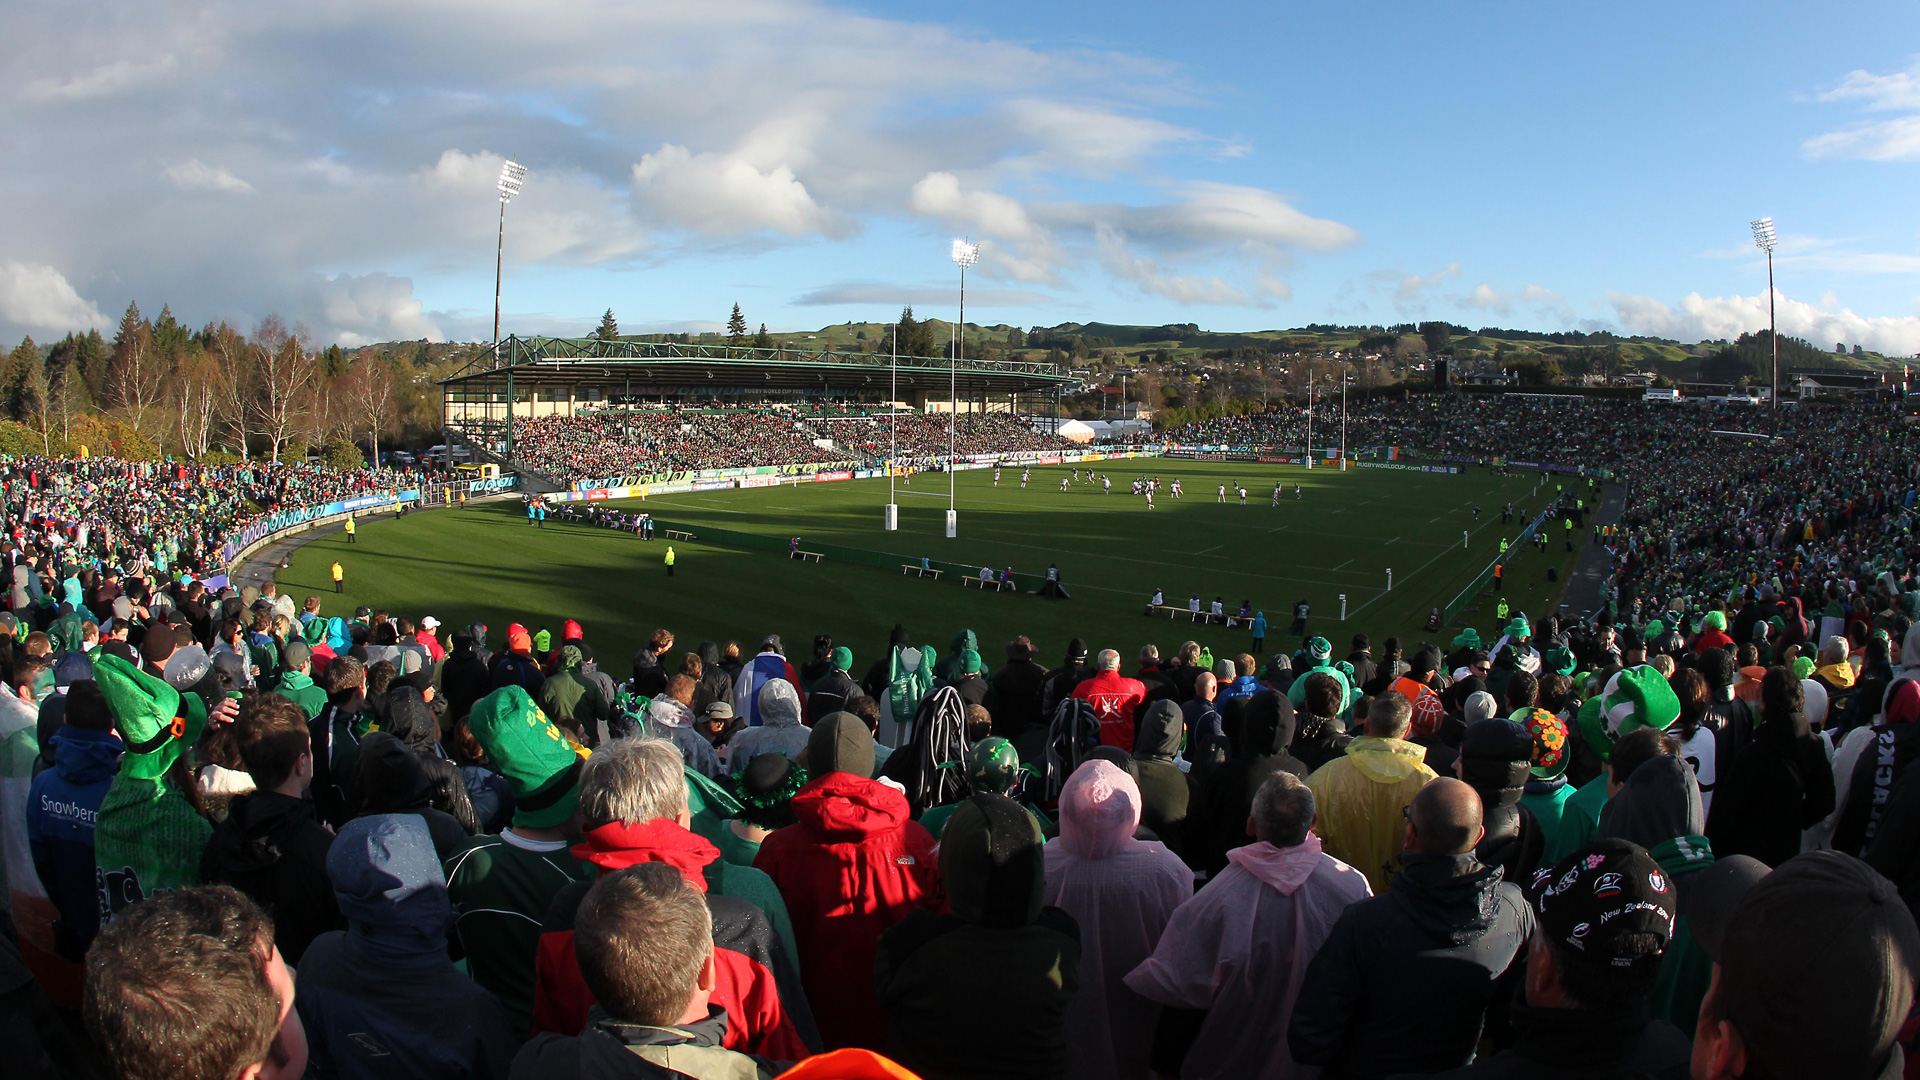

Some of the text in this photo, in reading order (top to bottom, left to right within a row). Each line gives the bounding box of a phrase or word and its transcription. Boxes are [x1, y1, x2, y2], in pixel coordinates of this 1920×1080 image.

[1356, 462, 1421, 471] RUGBYWORLDCUP.com
[744, 478, 777, 487] TOSHIBA
[1600, 908, 1621, 925] New
[1624, 900, 1658, 914] Zealand
